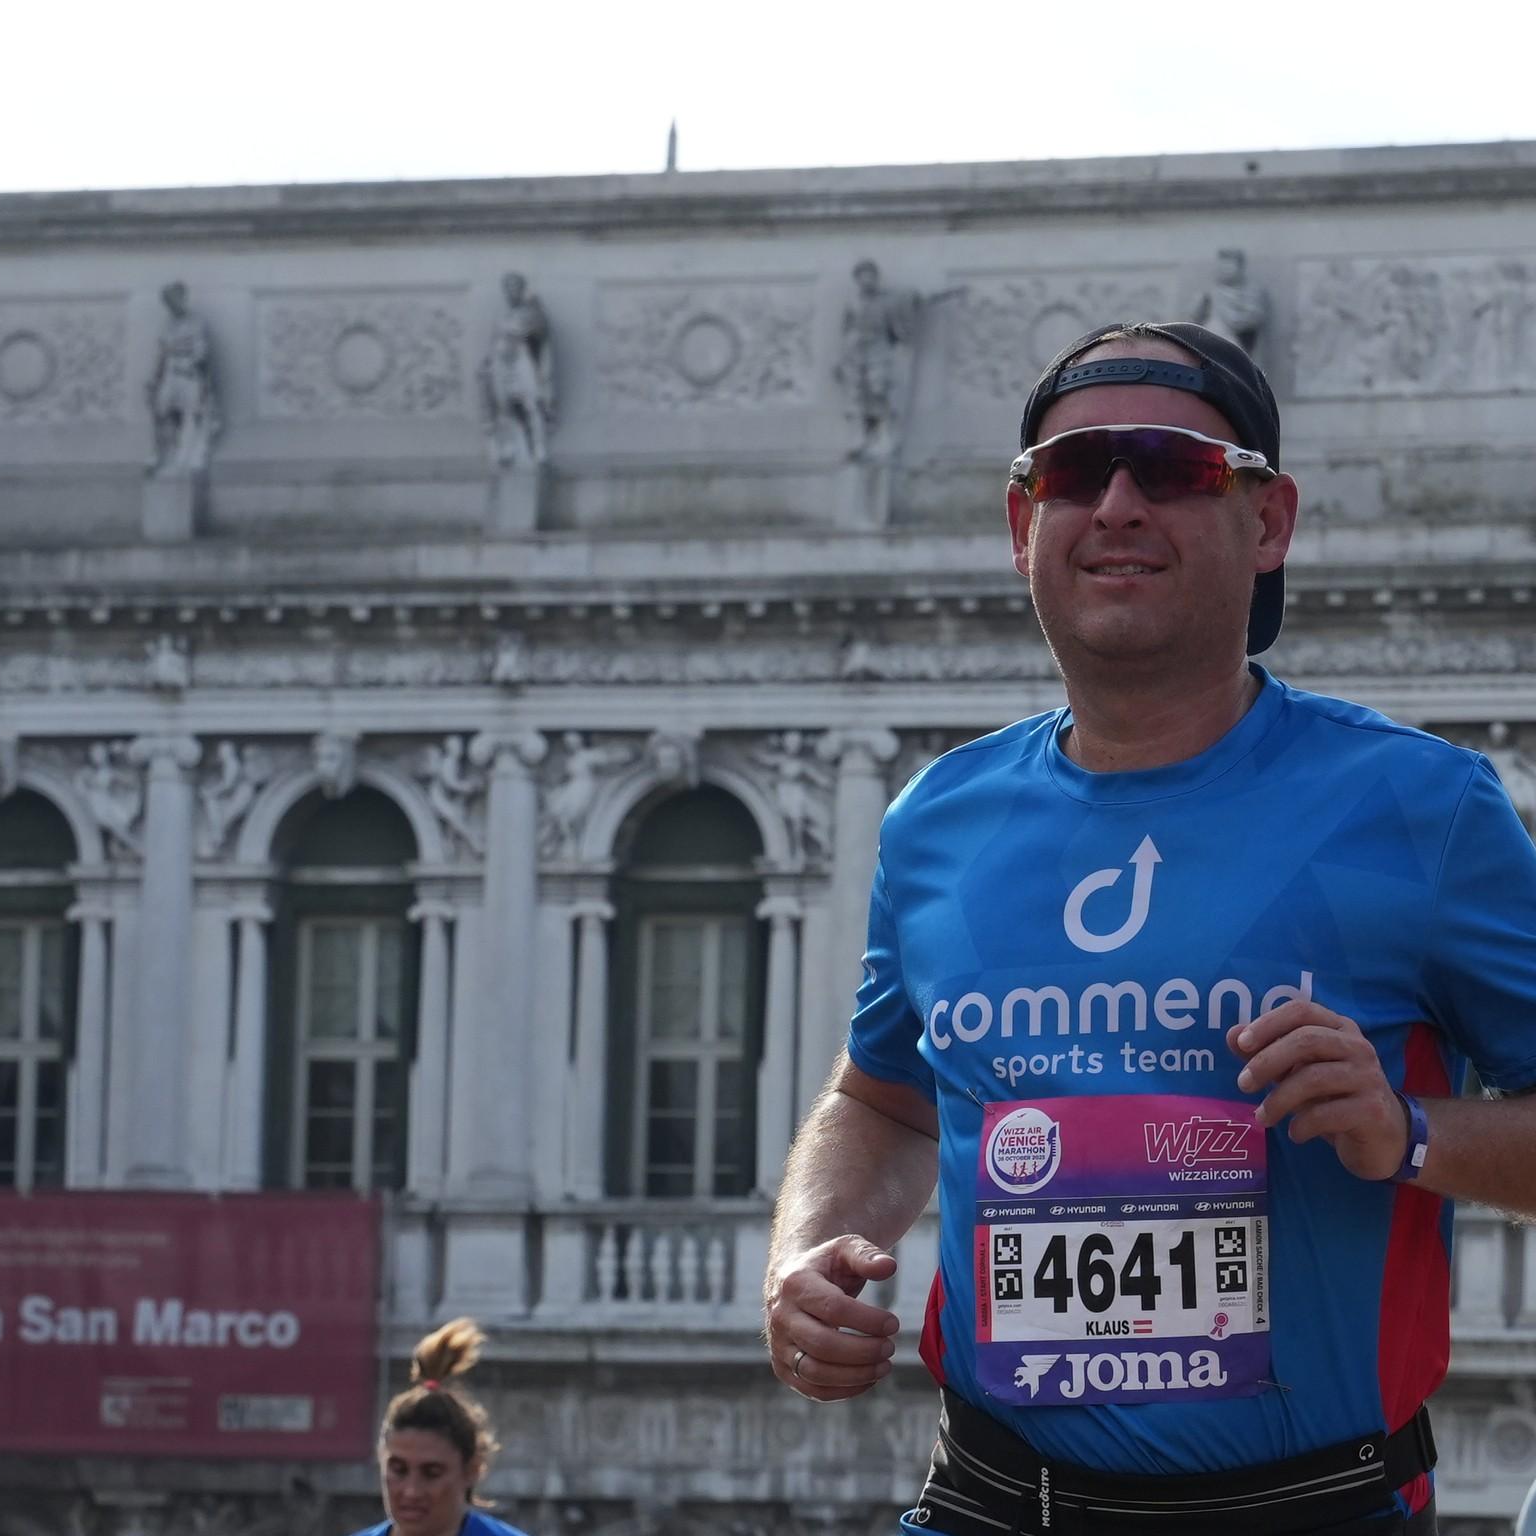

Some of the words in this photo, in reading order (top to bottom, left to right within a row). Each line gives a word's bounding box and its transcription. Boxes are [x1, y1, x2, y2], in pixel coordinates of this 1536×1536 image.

[929, 971, 1313, 1050] commend
[993, 1044, 1104, 1087] sports
[1120, 1041, 1215, 1074] team
[1004, 1127, 1025, 1136] WIZZ
[1027, 1126, 1042, 1135] AIR
[999, 1135, 1046, 1147] VENICE
[998, 1146, 1046, 1156] MARATHON
[1169, 1168, 1253, 1182] wizzair.com
[1067, 1206, 1107, 1215] HYUNDAI
[1138, 1204, 1180, 1213] HYUNDAI
[1213, 1201, 1255, 1210] HYUNDAI
[999, 1207, 1036, 1217] HYUNDAI
[1033, 1231, 1198, 1314] 4641
[19, 1294, 118, 1344] San
[133, 1298, 300, 1349] Marco
[1085, 1319, 1130, 1336] KLAUS
